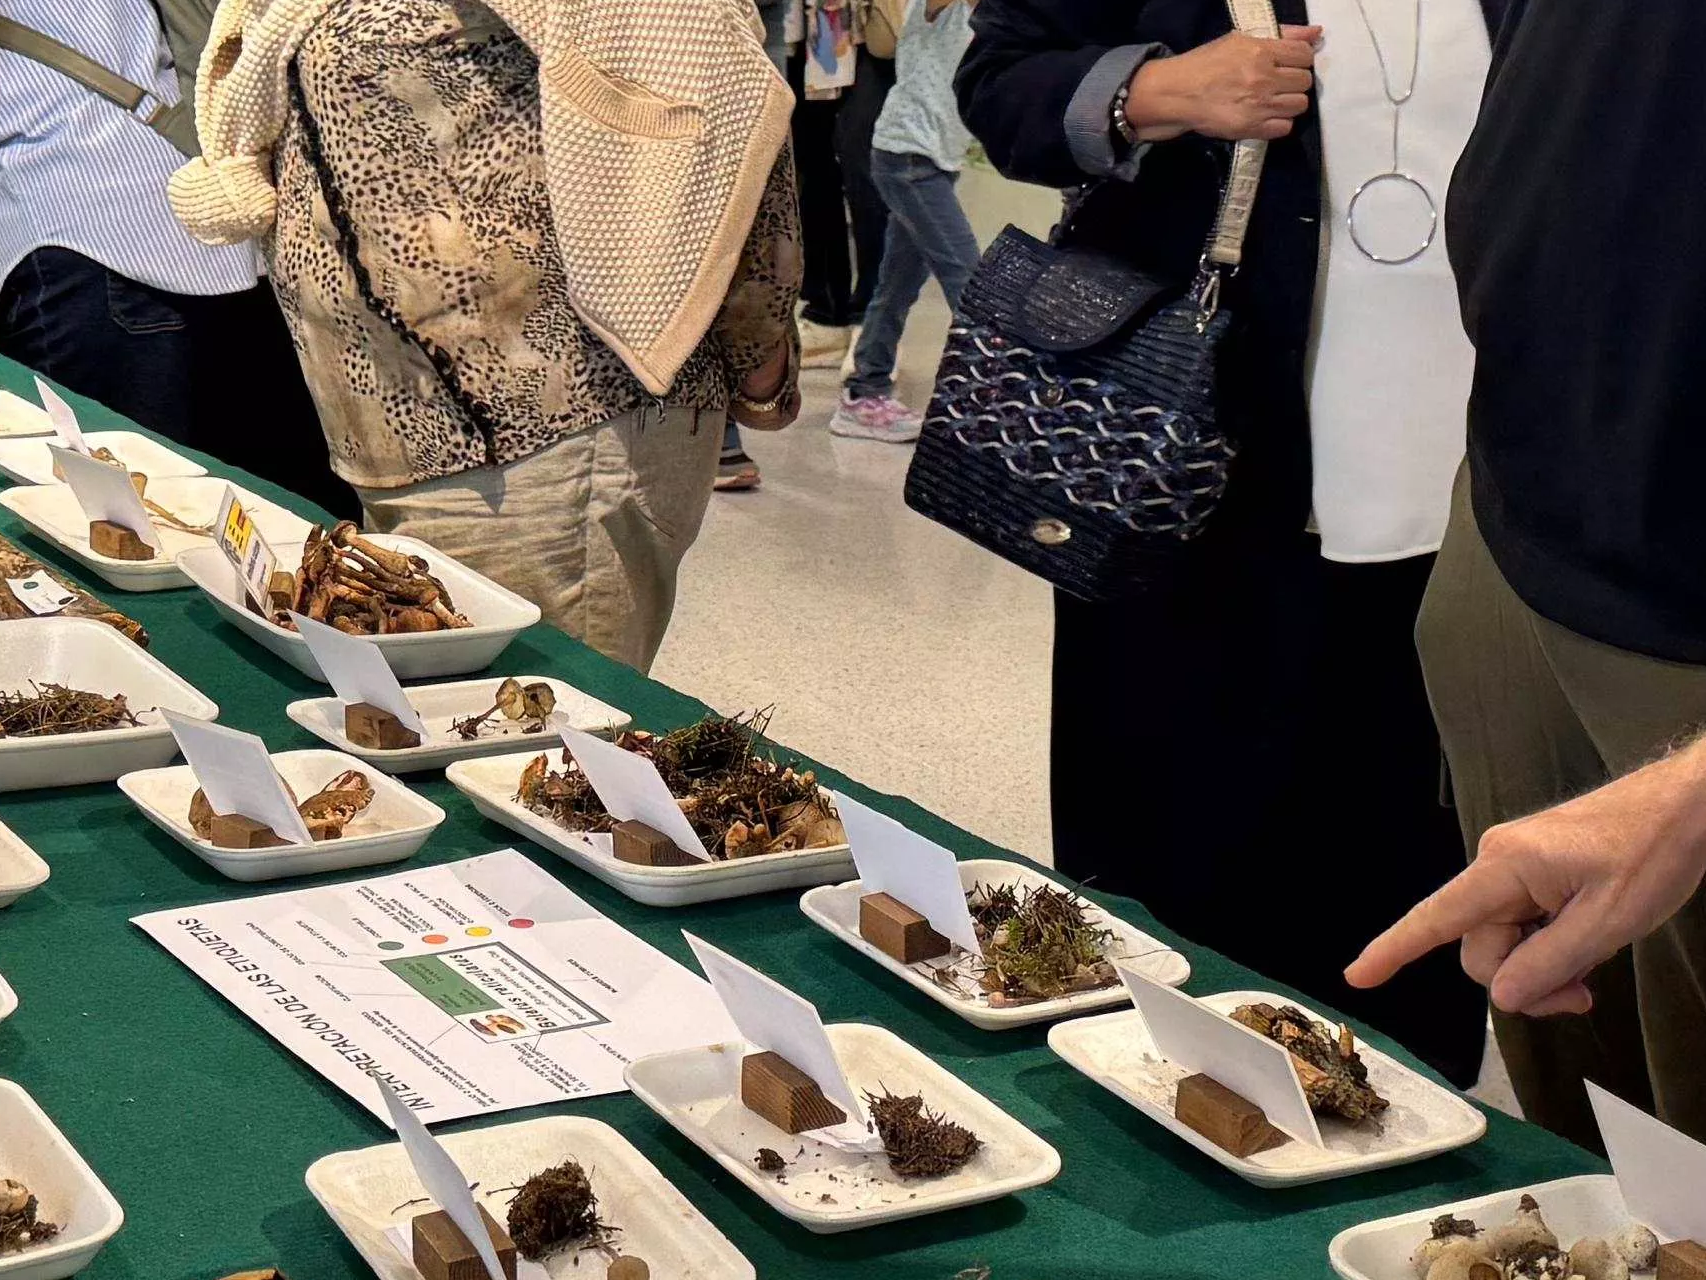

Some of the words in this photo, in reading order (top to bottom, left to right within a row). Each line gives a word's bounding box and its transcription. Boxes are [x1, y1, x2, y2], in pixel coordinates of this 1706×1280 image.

[173, 917, 261, 972] ETIQUETAS
[244, 972, 288, 995] LAS
[272, 995, 310, 1013] DE
